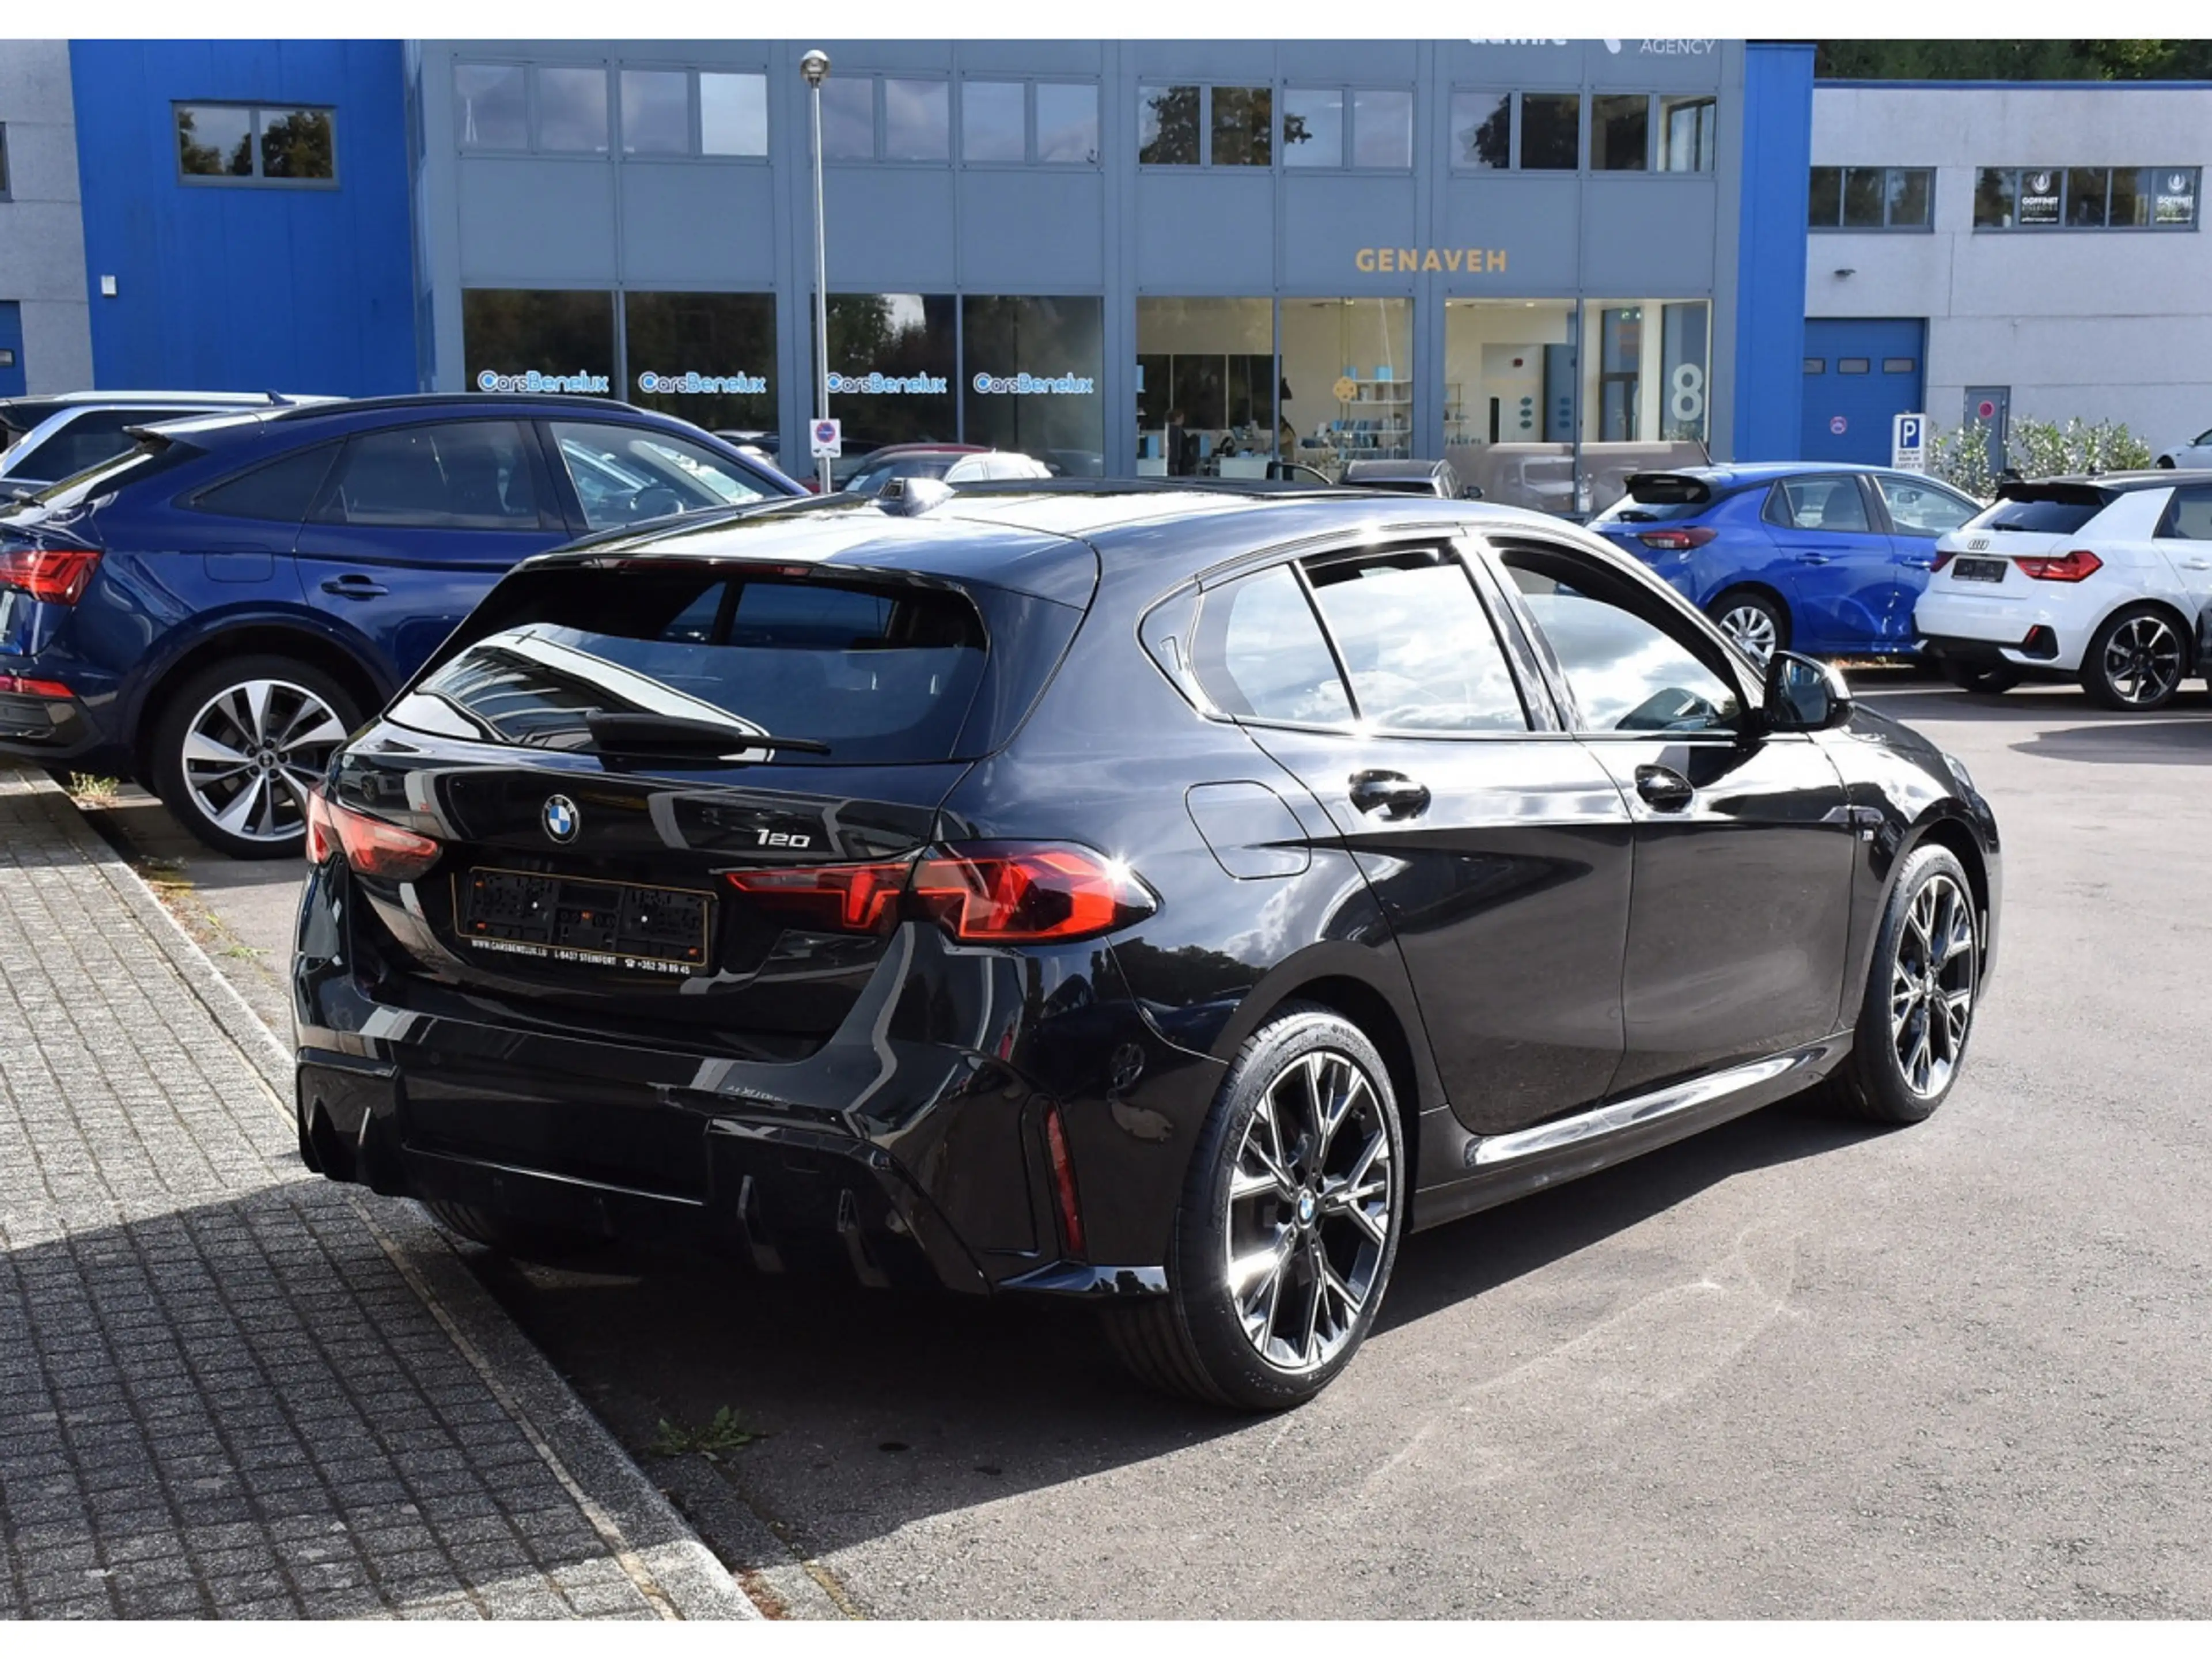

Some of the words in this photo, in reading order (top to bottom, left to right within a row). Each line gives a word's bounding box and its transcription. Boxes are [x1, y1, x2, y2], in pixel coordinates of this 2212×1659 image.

[1639, 39, 1715, 55] AGENCY
[1355, 248, 1506, 272] GENAVEH
[478, 369, 609, 393] CarsBenelux
[638, 370, 767, 393] CarsBenelux
[827, 371, 948, 394] CarsBenelux
[973, 372, 1094, 394] CarsBenelux
[1672, 363, 1703, 422] 8
[1903, 421, 1916, 446] P
[757, 829, 810, 848] 120
